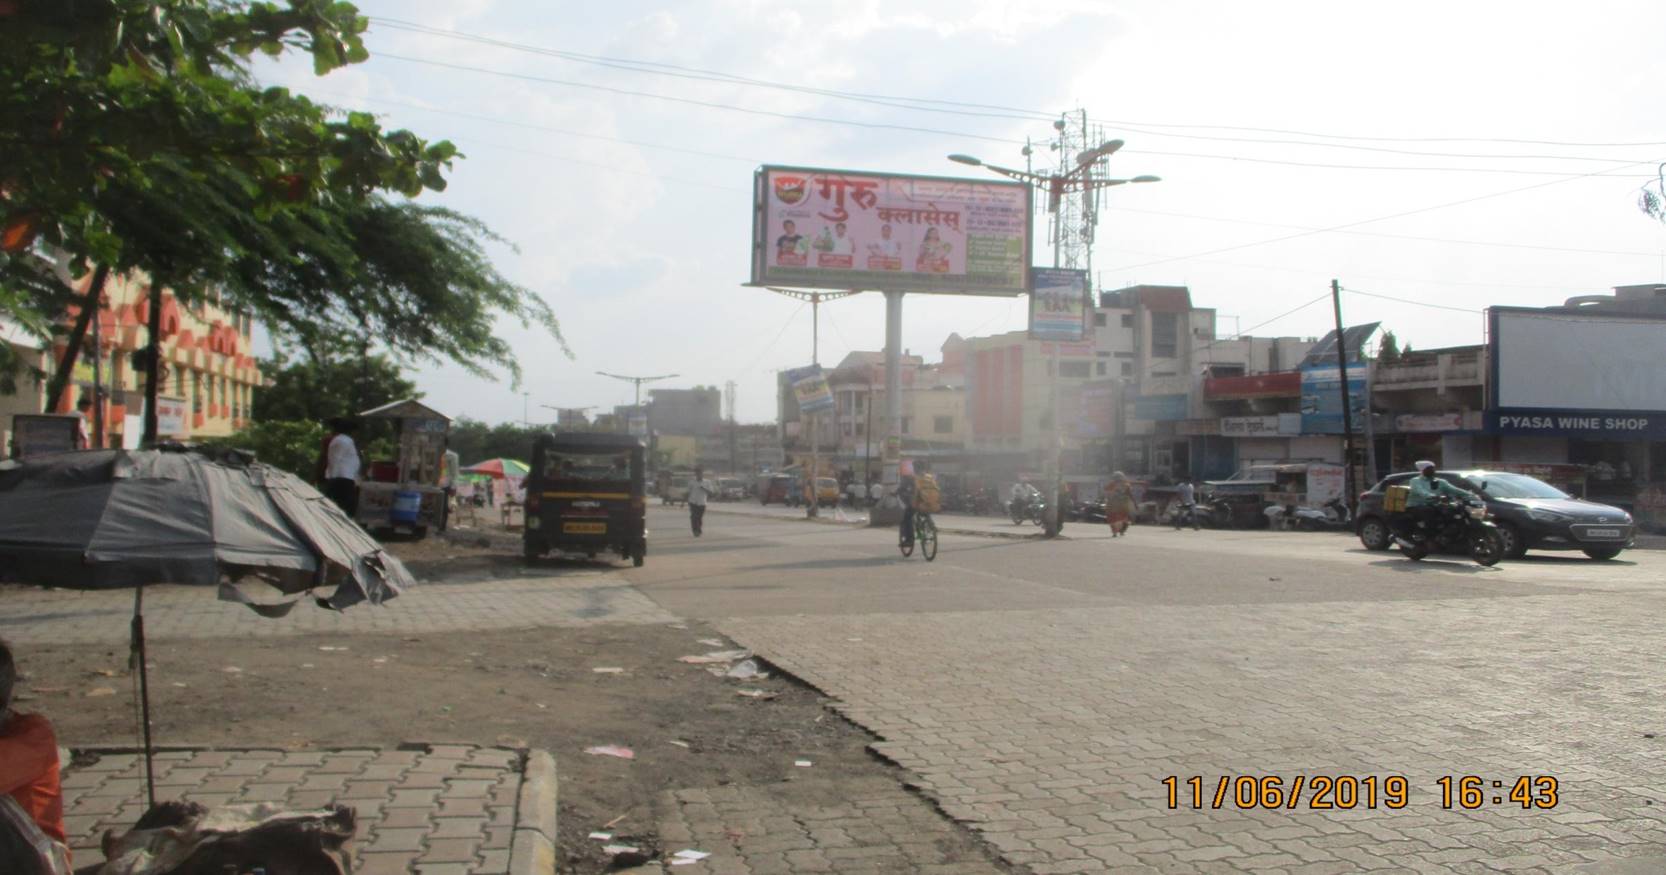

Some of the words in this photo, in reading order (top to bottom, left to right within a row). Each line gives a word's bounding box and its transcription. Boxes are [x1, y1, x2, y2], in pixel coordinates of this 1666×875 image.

[815, 178, 878, 222] गुरु
[1499, 416, 1553, 429] PYASA
[1558, 418, 1601, 430] WINE
[1605, 418, 1649, 431] SHOP
